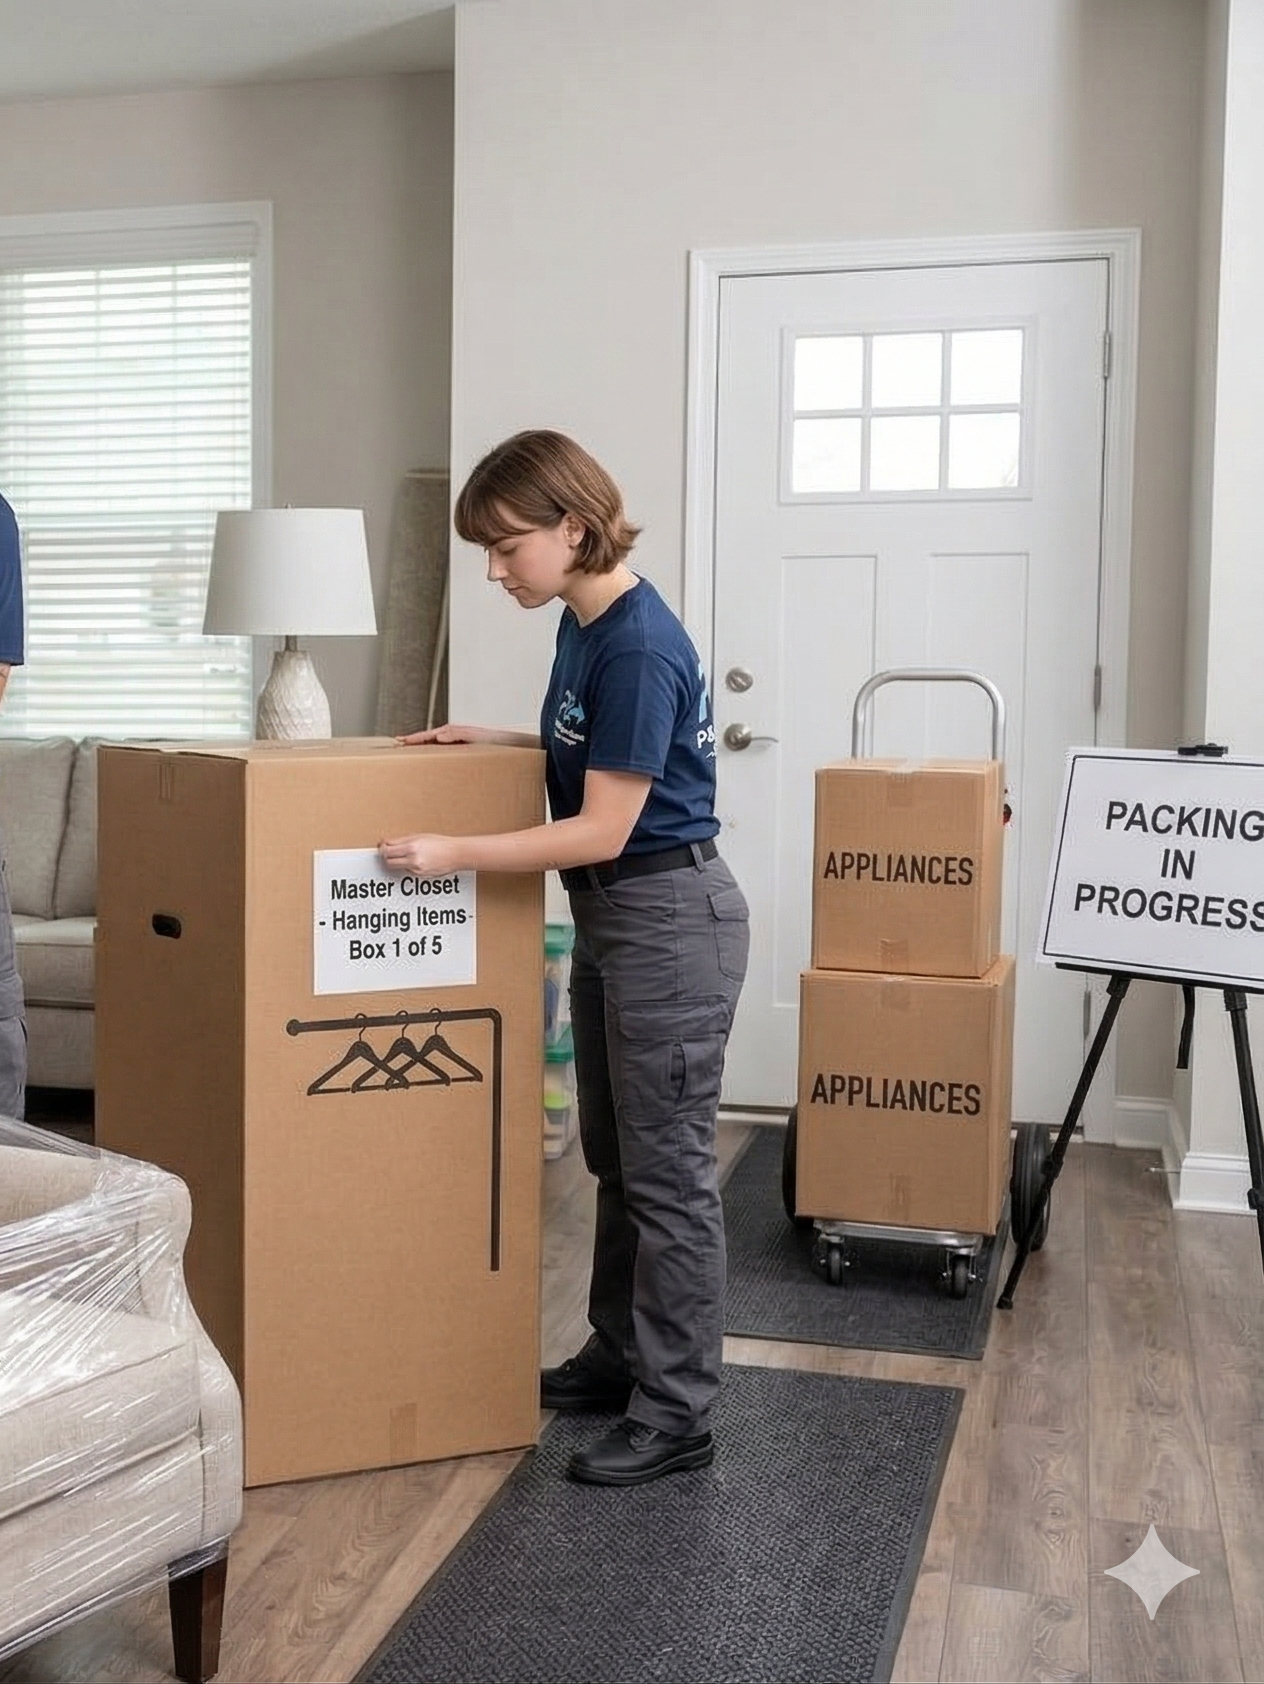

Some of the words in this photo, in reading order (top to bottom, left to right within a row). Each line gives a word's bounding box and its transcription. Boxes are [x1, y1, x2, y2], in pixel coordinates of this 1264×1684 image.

[1105, 801, 1264, 842] PACKING
[823, 851, 974, 886] APPLIANCES
[1160, 848, 1195, 880] IN
[331, 879, 394, 900] Master
[400, 875, 460, 896] Closet
[333, 908, 410, 934] Hanging
[349, 939, 386, 960] Box
[392, 938, 400, 957] 1
[408, 936, 427, 956] of
[431, 935, 442, 955] 5
[810, 1073, 981, 1116] APPLIANCES
